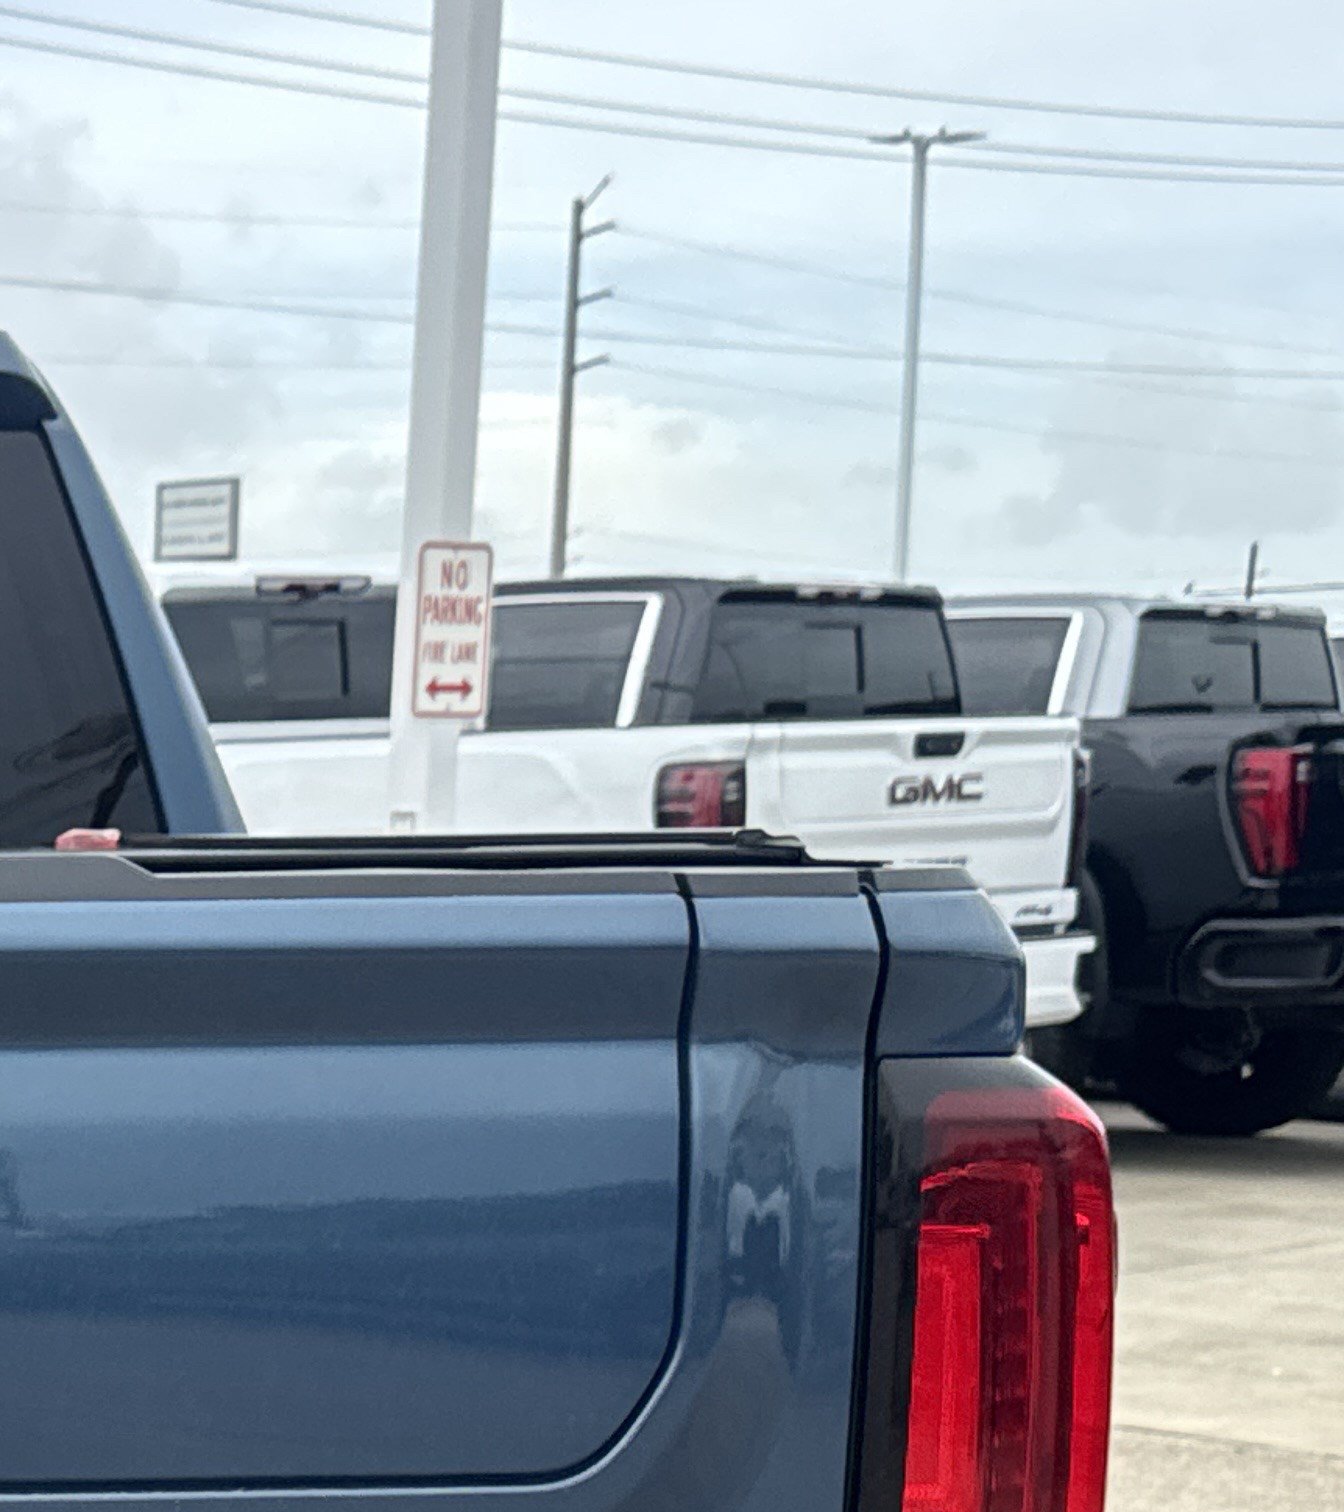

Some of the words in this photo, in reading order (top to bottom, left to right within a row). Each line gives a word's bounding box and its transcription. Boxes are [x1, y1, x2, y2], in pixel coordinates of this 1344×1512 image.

[441, 559, 468, 590] NO
[422, 594, 483, 626] PARKING
[888, 772, 983, 806] GMC
